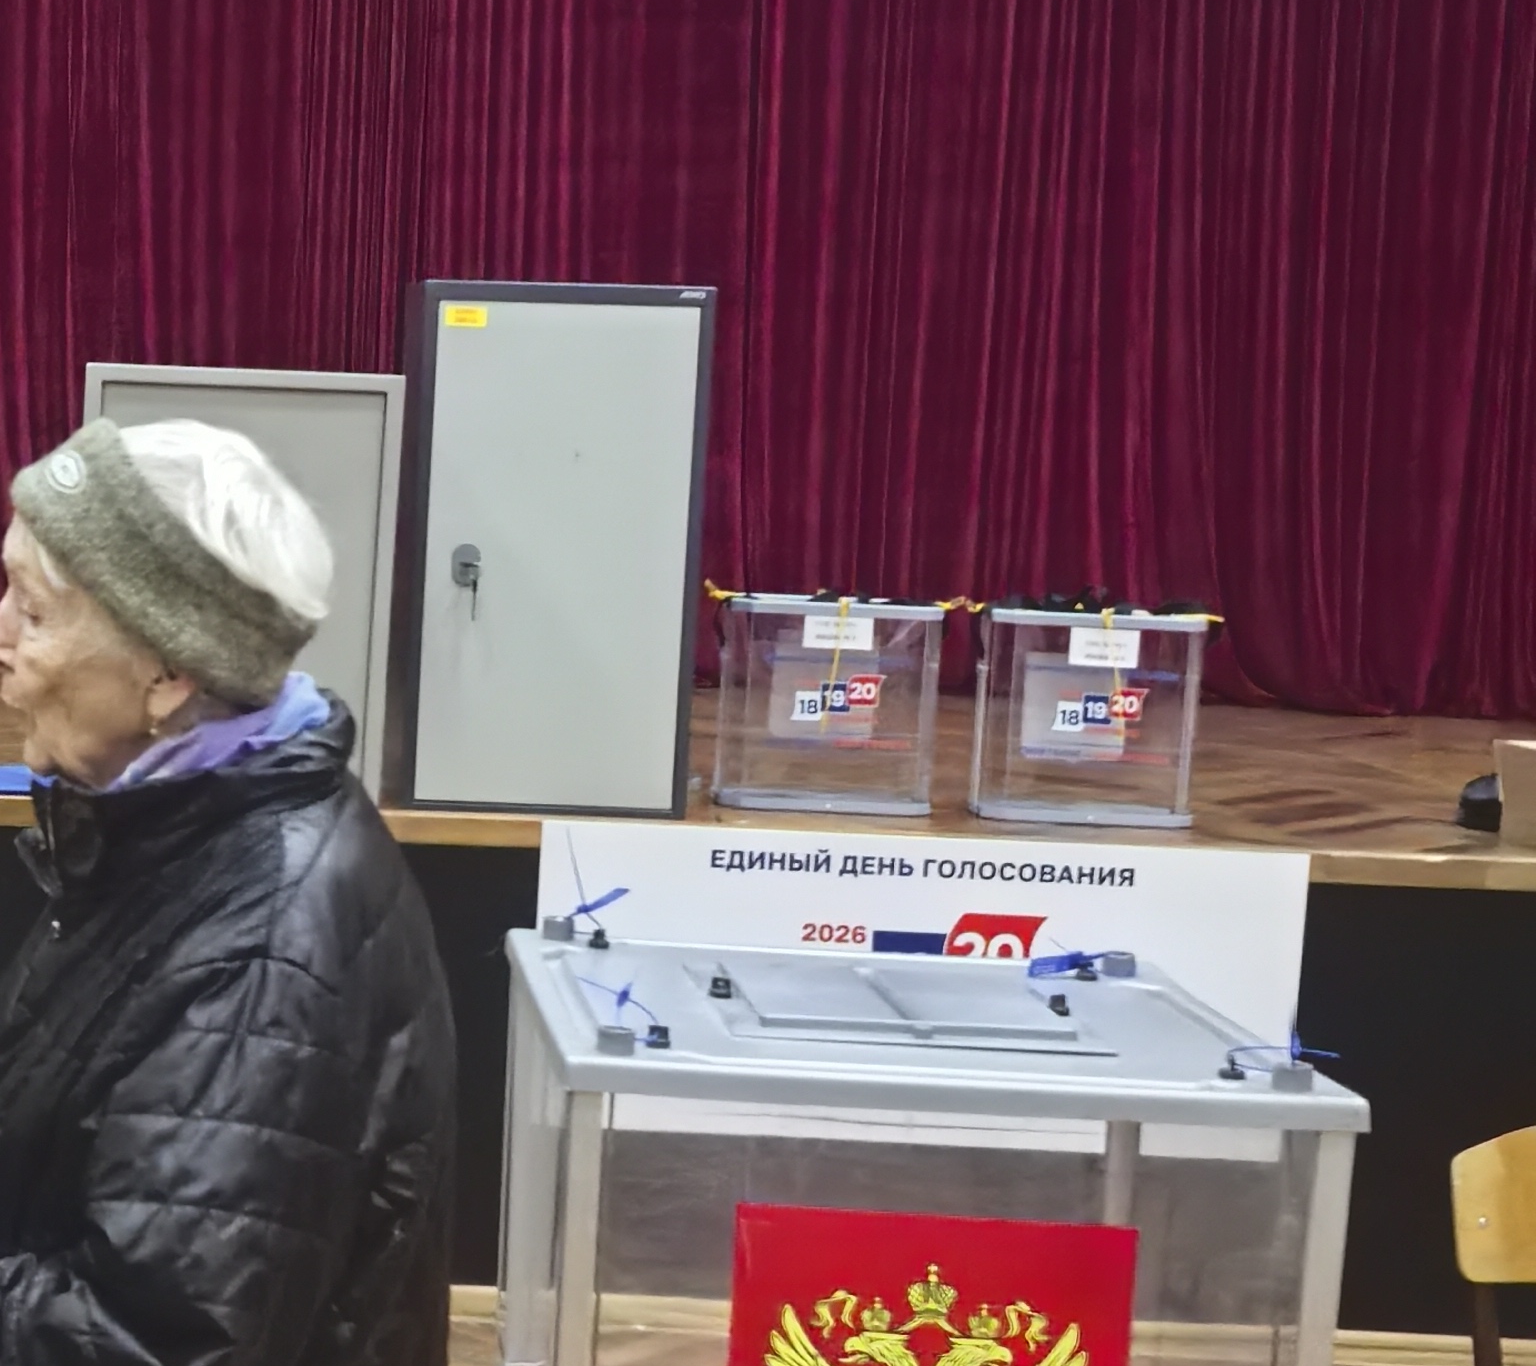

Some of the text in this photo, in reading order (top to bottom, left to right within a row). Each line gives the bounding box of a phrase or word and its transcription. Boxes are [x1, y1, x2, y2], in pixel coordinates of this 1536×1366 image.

[799, 699, 818, 714] 18
[849, 683, 877, 700] 20
[1060, 695, 1138, 726] 18 19 20
[711, 848, 1136, 888] ЕДИНЫЙ ДЕНЬ ГОЛОСОВАНИЯ
[802, 923, 868, 945] 2026
